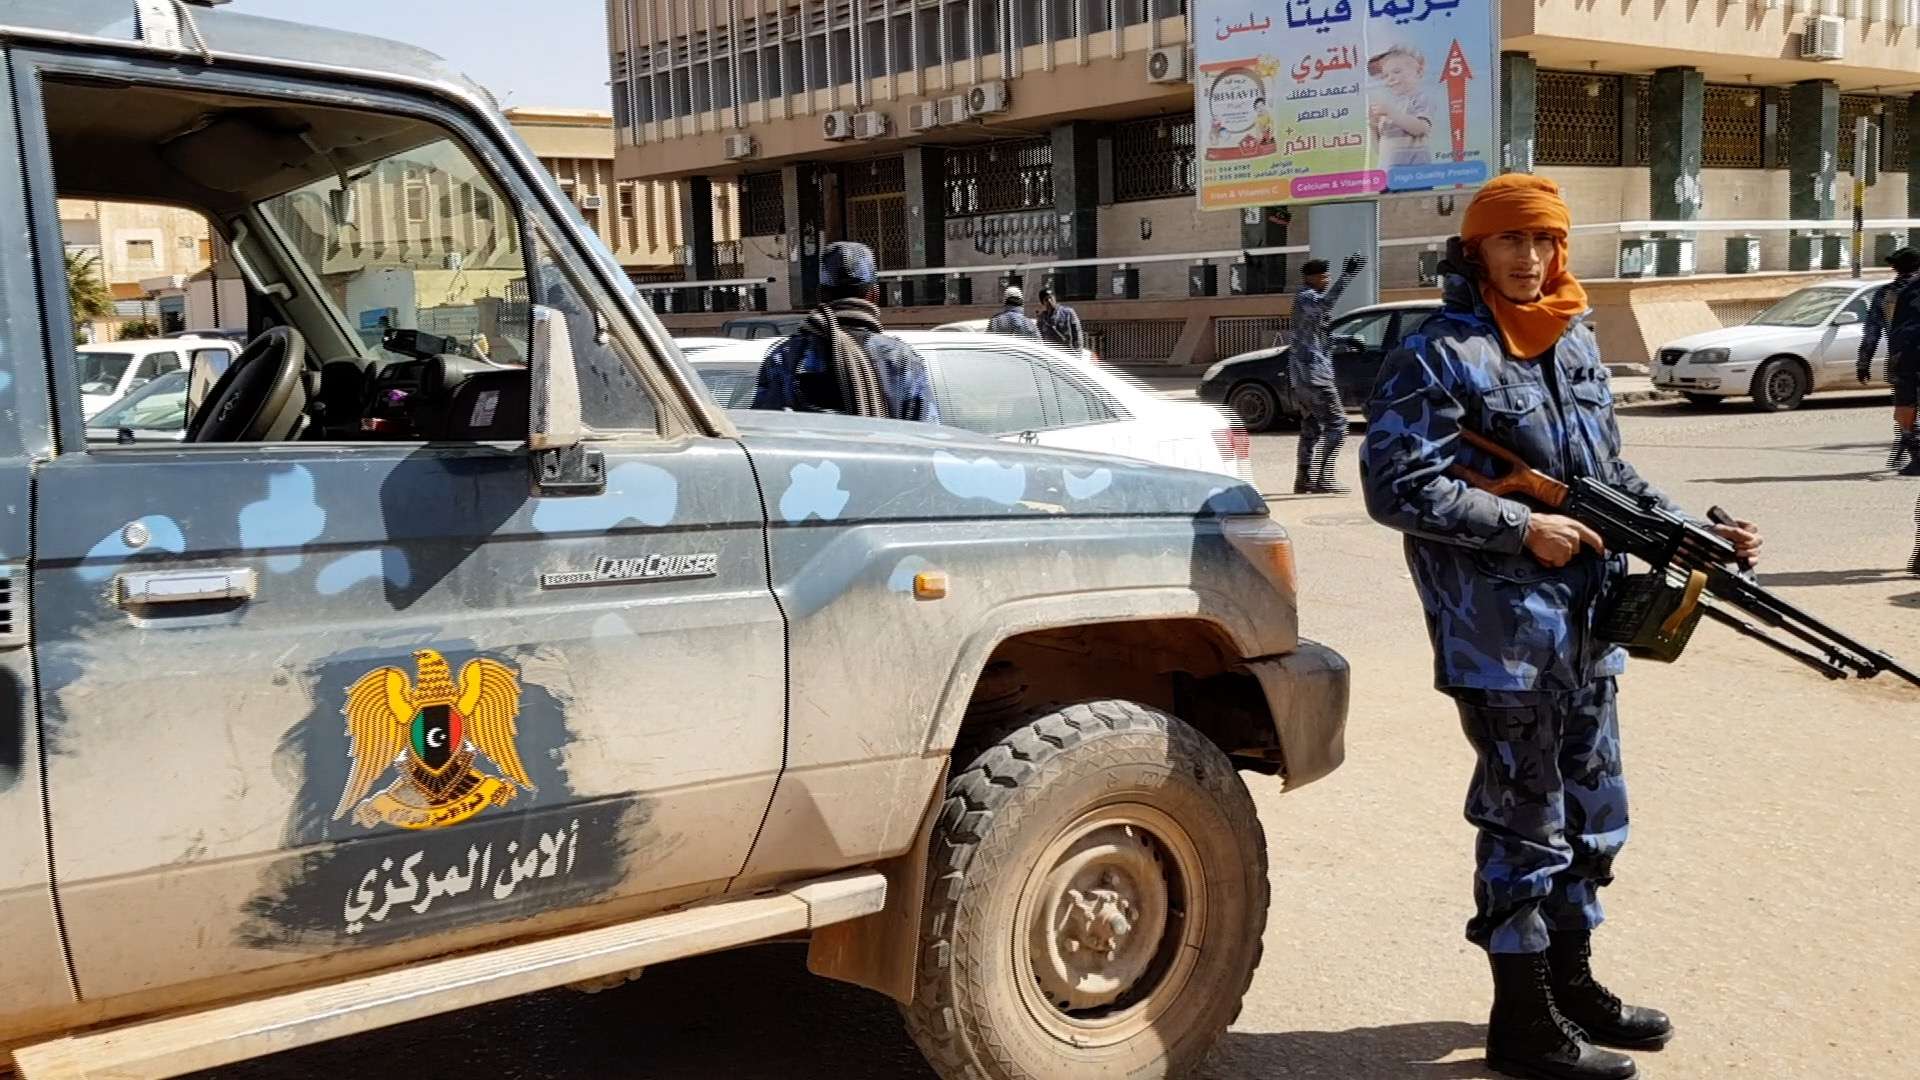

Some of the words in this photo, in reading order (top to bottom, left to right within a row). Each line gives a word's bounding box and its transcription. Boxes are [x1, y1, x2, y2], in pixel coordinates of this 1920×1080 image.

[1216, 11, 1271, 40] بلس
[1290, 45, 1358, 84] المقوي
[1297, 180, 1331, 191] Calcium
[343, 842, 494, 935] المركزي
